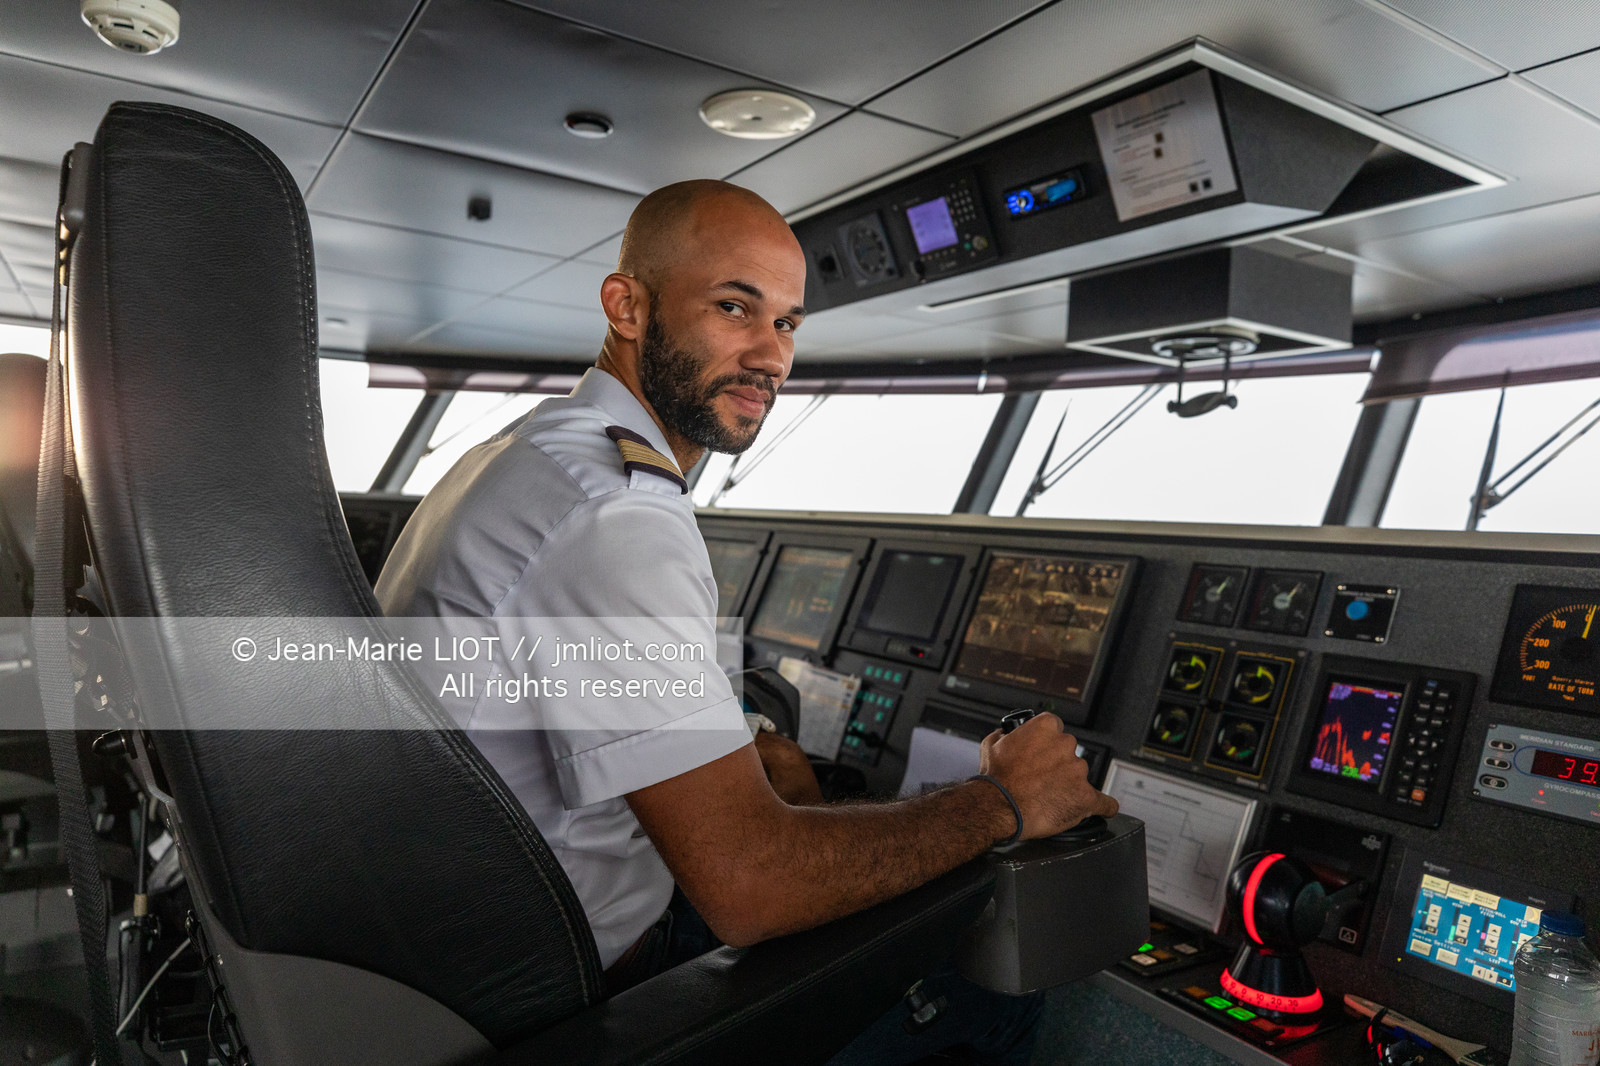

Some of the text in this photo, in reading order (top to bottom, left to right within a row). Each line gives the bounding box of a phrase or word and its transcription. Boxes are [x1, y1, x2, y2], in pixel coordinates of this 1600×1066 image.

[1552, 620, 1567, 629] 100
[1533, 638, 1550, 648] 200
[1534, 659, 1550, 670] 300
[1547, 682, 1595, 696] RATE OF TURN
[1555, 739, 1594, 752] STANDARD
[1256, 993, 1265, 1001] 10
[1271, 997, 1282, 1006] 20
[1288, 999, 1299, 1008] 30
